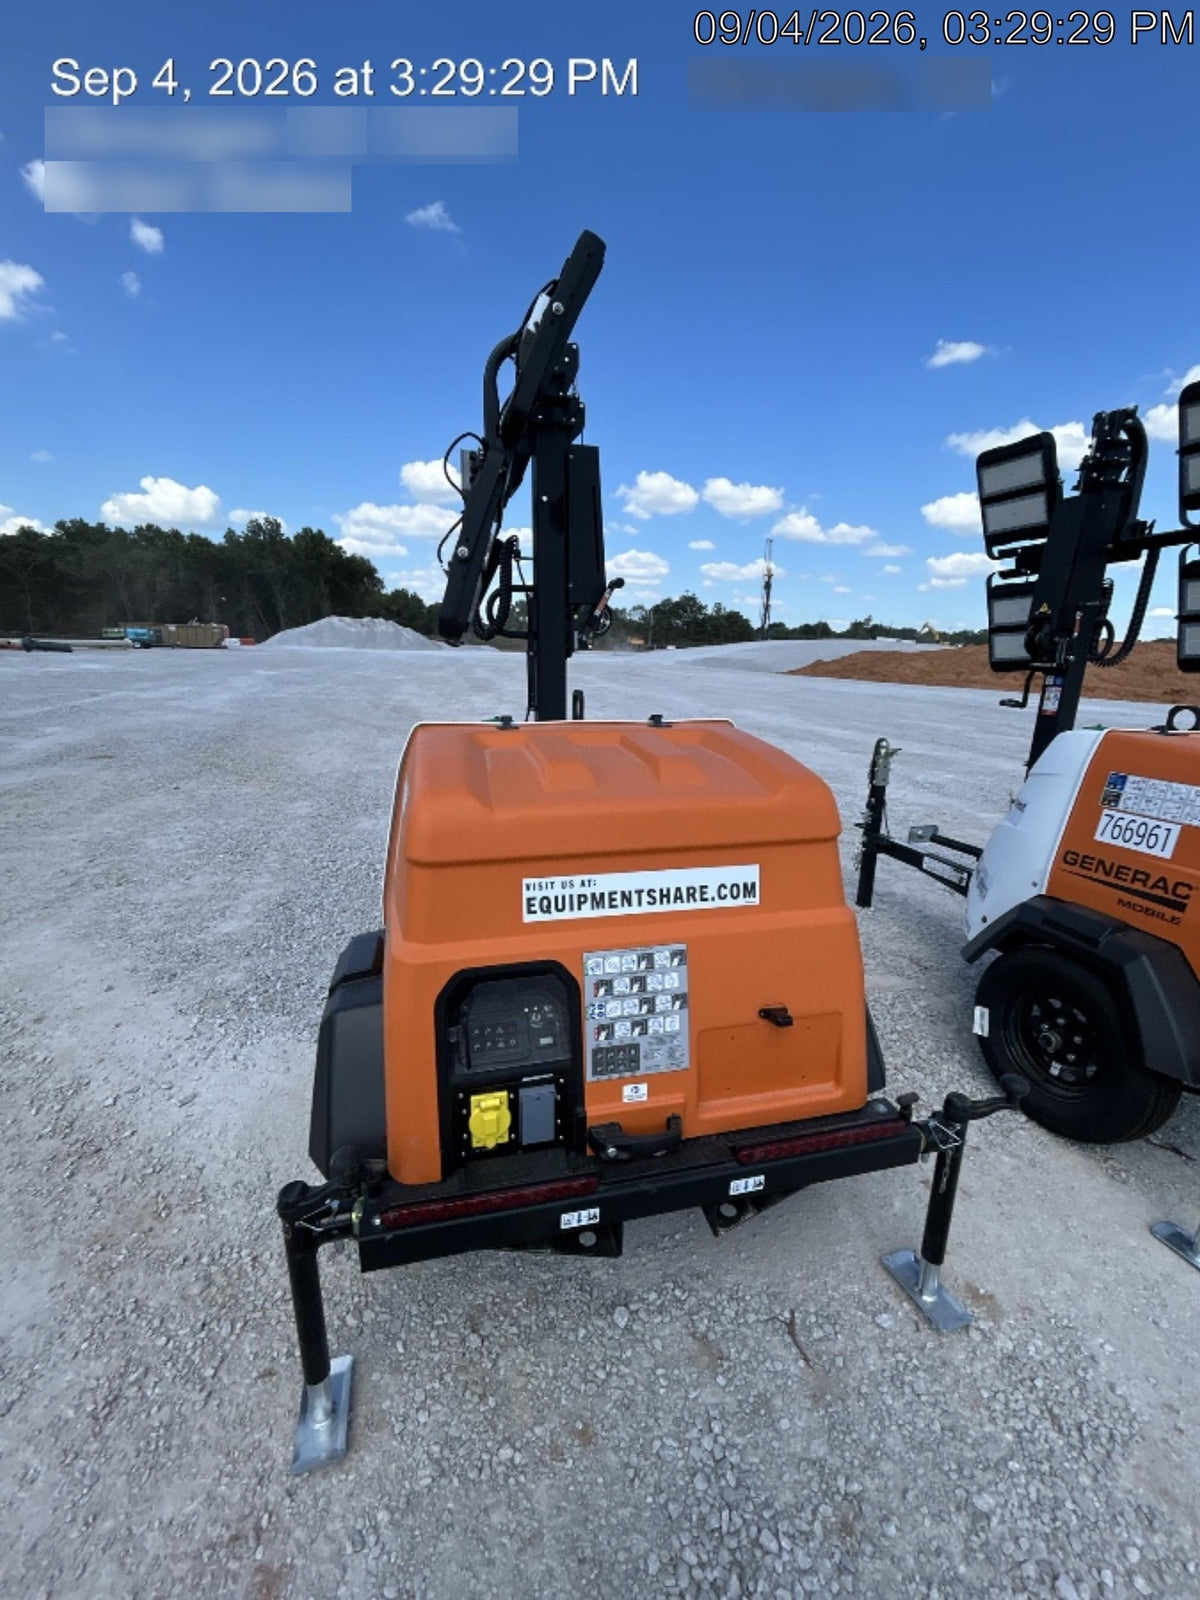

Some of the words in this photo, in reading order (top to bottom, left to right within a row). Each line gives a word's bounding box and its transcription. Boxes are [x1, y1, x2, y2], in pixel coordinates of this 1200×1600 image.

[1100, 813, 1172, 852] 766961
[525, 881, 556, 892] VISIT
[561, 879, 576, 889] US
[579, 878, 598, 888] AT:
[1062, 850, 1194, 901] GENERAC
[525, 882, 757, 915] EQUIPMENTSHARE.COM
[1117, 899, 1182, 925] MOBILE
